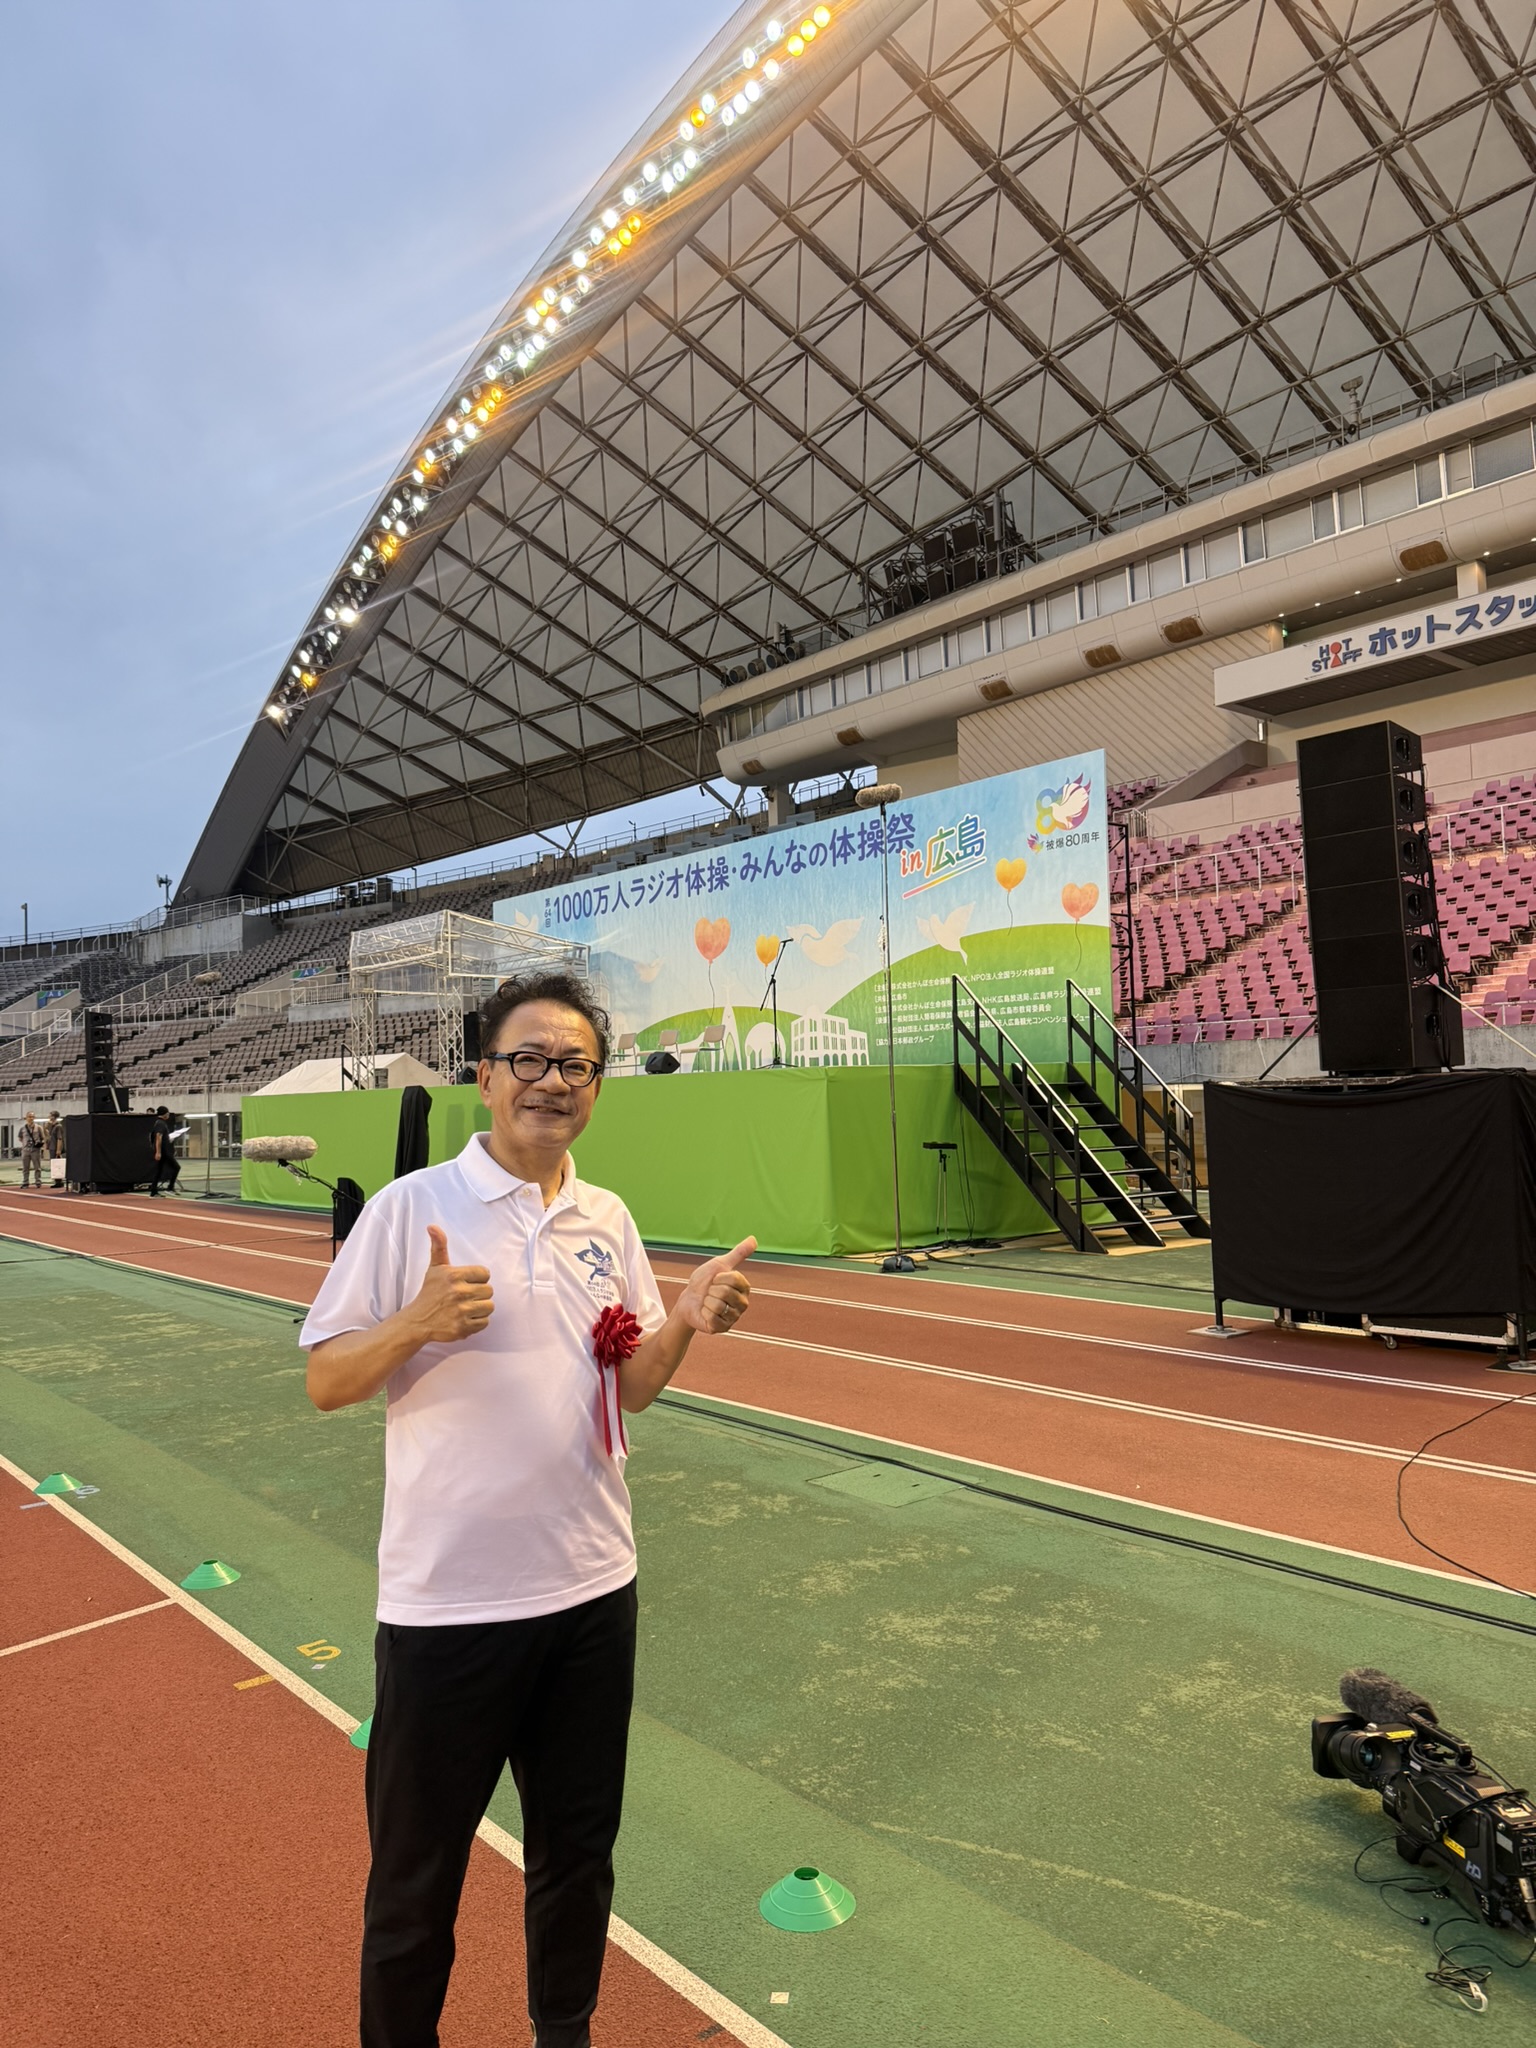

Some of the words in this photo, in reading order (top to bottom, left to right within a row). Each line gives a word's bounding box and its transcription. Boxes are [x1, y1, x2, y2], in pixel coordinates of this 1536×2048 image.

[1368, 594, 1536, 657] ホットスタッ
[900, 847, 923, 877] in
[925, 813, 986, 878] 広島
[1045, 831, 1100, 851] 被爆80周年
[296, 1639, 342, 1661] 5
